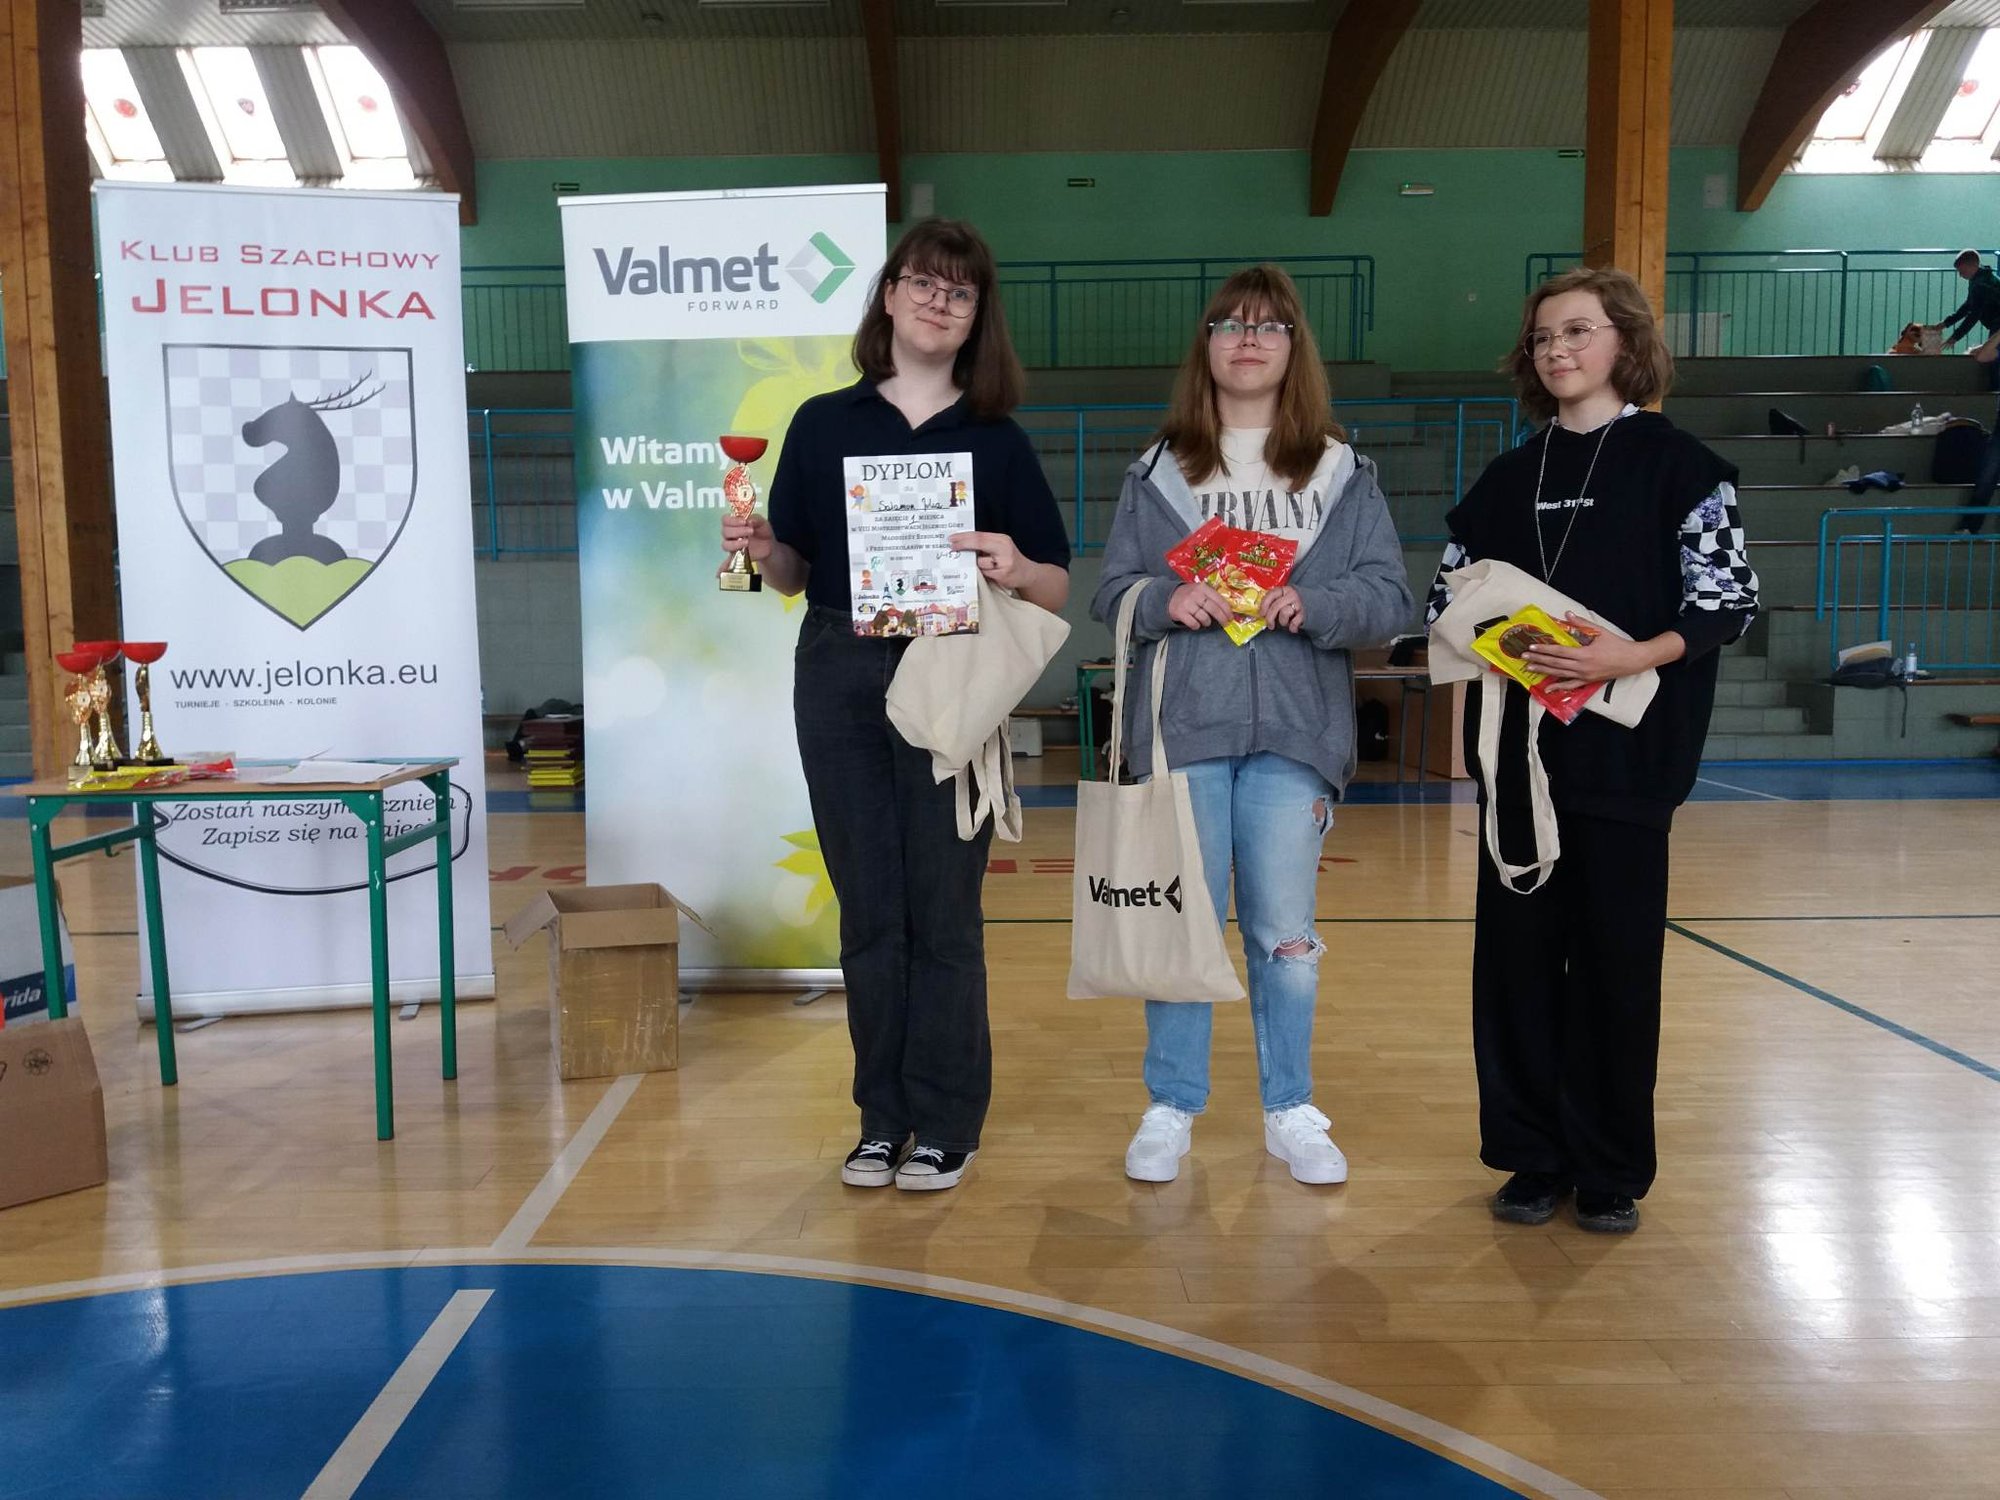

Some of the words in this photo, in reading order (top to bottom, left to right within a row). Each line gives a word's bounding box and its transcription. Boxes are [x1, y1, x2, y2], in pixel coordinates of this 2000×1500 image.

[120, 240, 219, 263] KLUB
[241, 245, 440, 270] SZACHOWY
[593, 242, 780, 296] Valmet
[132, 278, 436, 320] JELONKA
[688, 300, 779, 312] FORWARD
[600, 435, 730, 471] Witamy
[862, 461, 953, 481] DYPLOM
[602, 488, 633, 509] w
[640, 480, 763, 509] Valmt
[1537, 501, 1561, 510] West
[170, 659, 438, 695] www.jelonka.eu
[175, 700, 220, 709] TURNIEJE
[233, 699, 285, 708] SZKOLENIA
[297, 697, 337, 706] KOLONIE
[172, 800, 254, 821] Zostań
[202, 825, 280, 849] Zapisz
[287, 823, 320, 843] się
[328, 825, 358, 839] na
[4, 986, 42, 1008] rida
